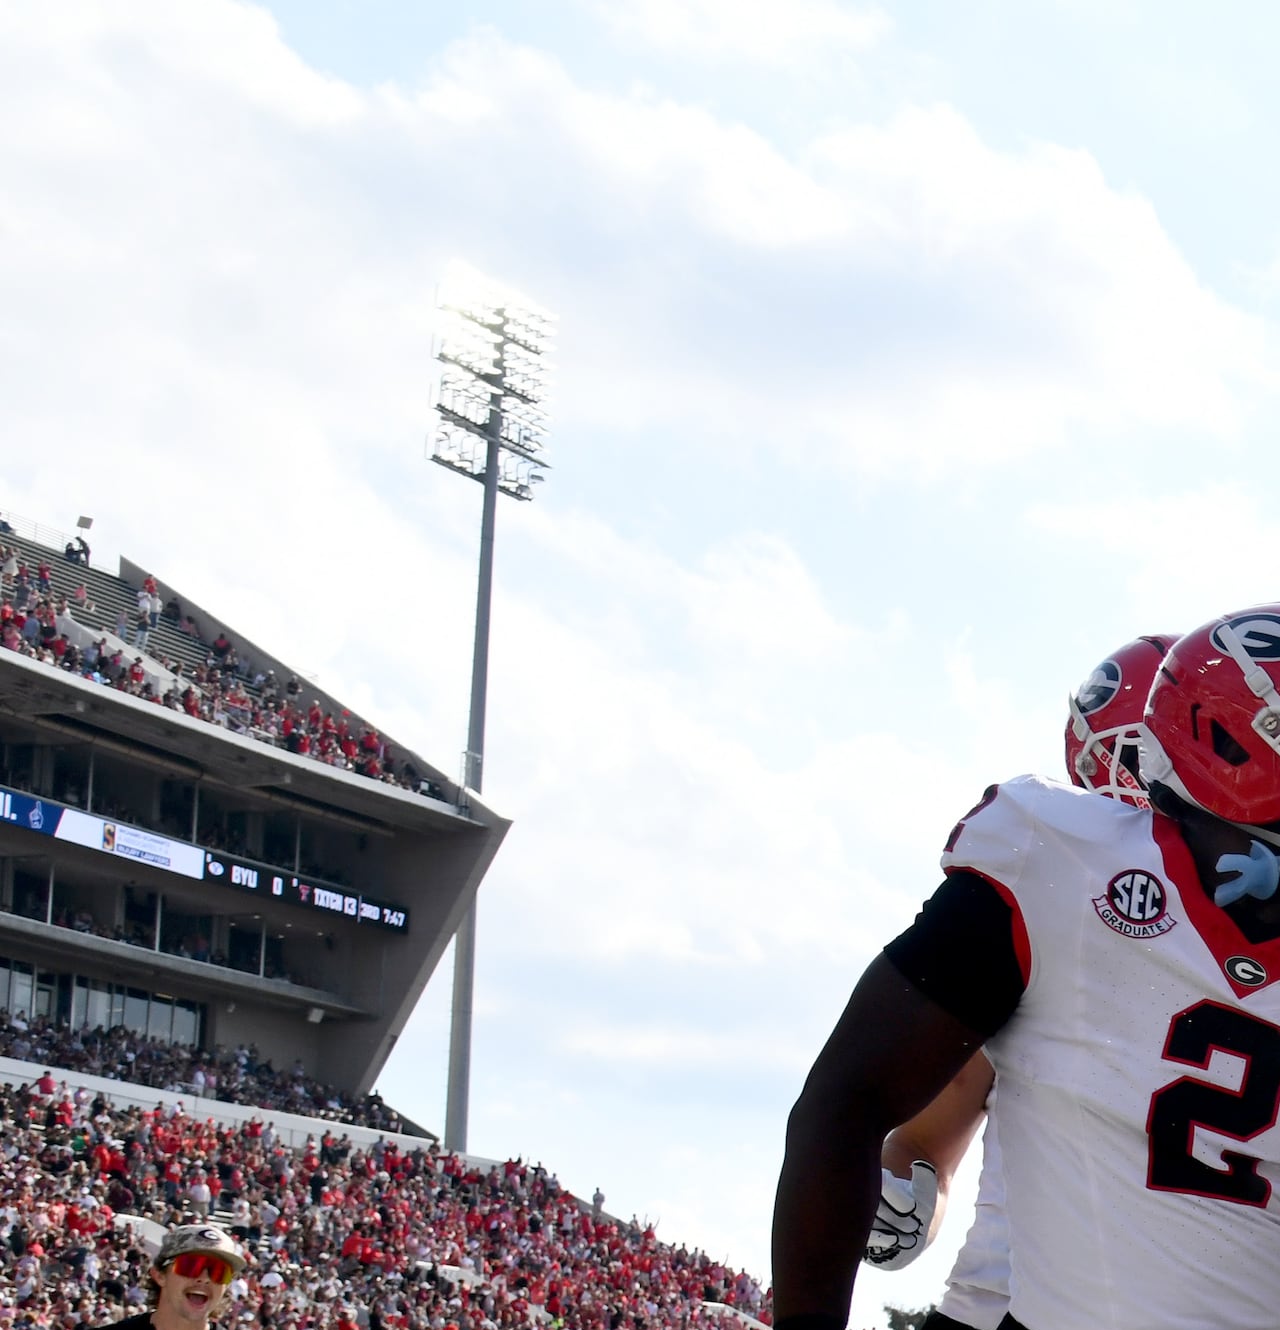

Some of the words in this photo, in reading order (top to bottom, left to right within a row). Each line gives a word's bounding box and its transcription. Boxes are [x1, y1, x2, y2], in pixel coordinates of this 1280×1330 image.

[232, 865, 258, 889] BYU
[272, 877, 283, 896] 0
[1113, 873, 1162, 920] SEC
[1101, 908, 1166, 937] GRADUATE
[1225, 955, 1267, 986] G
